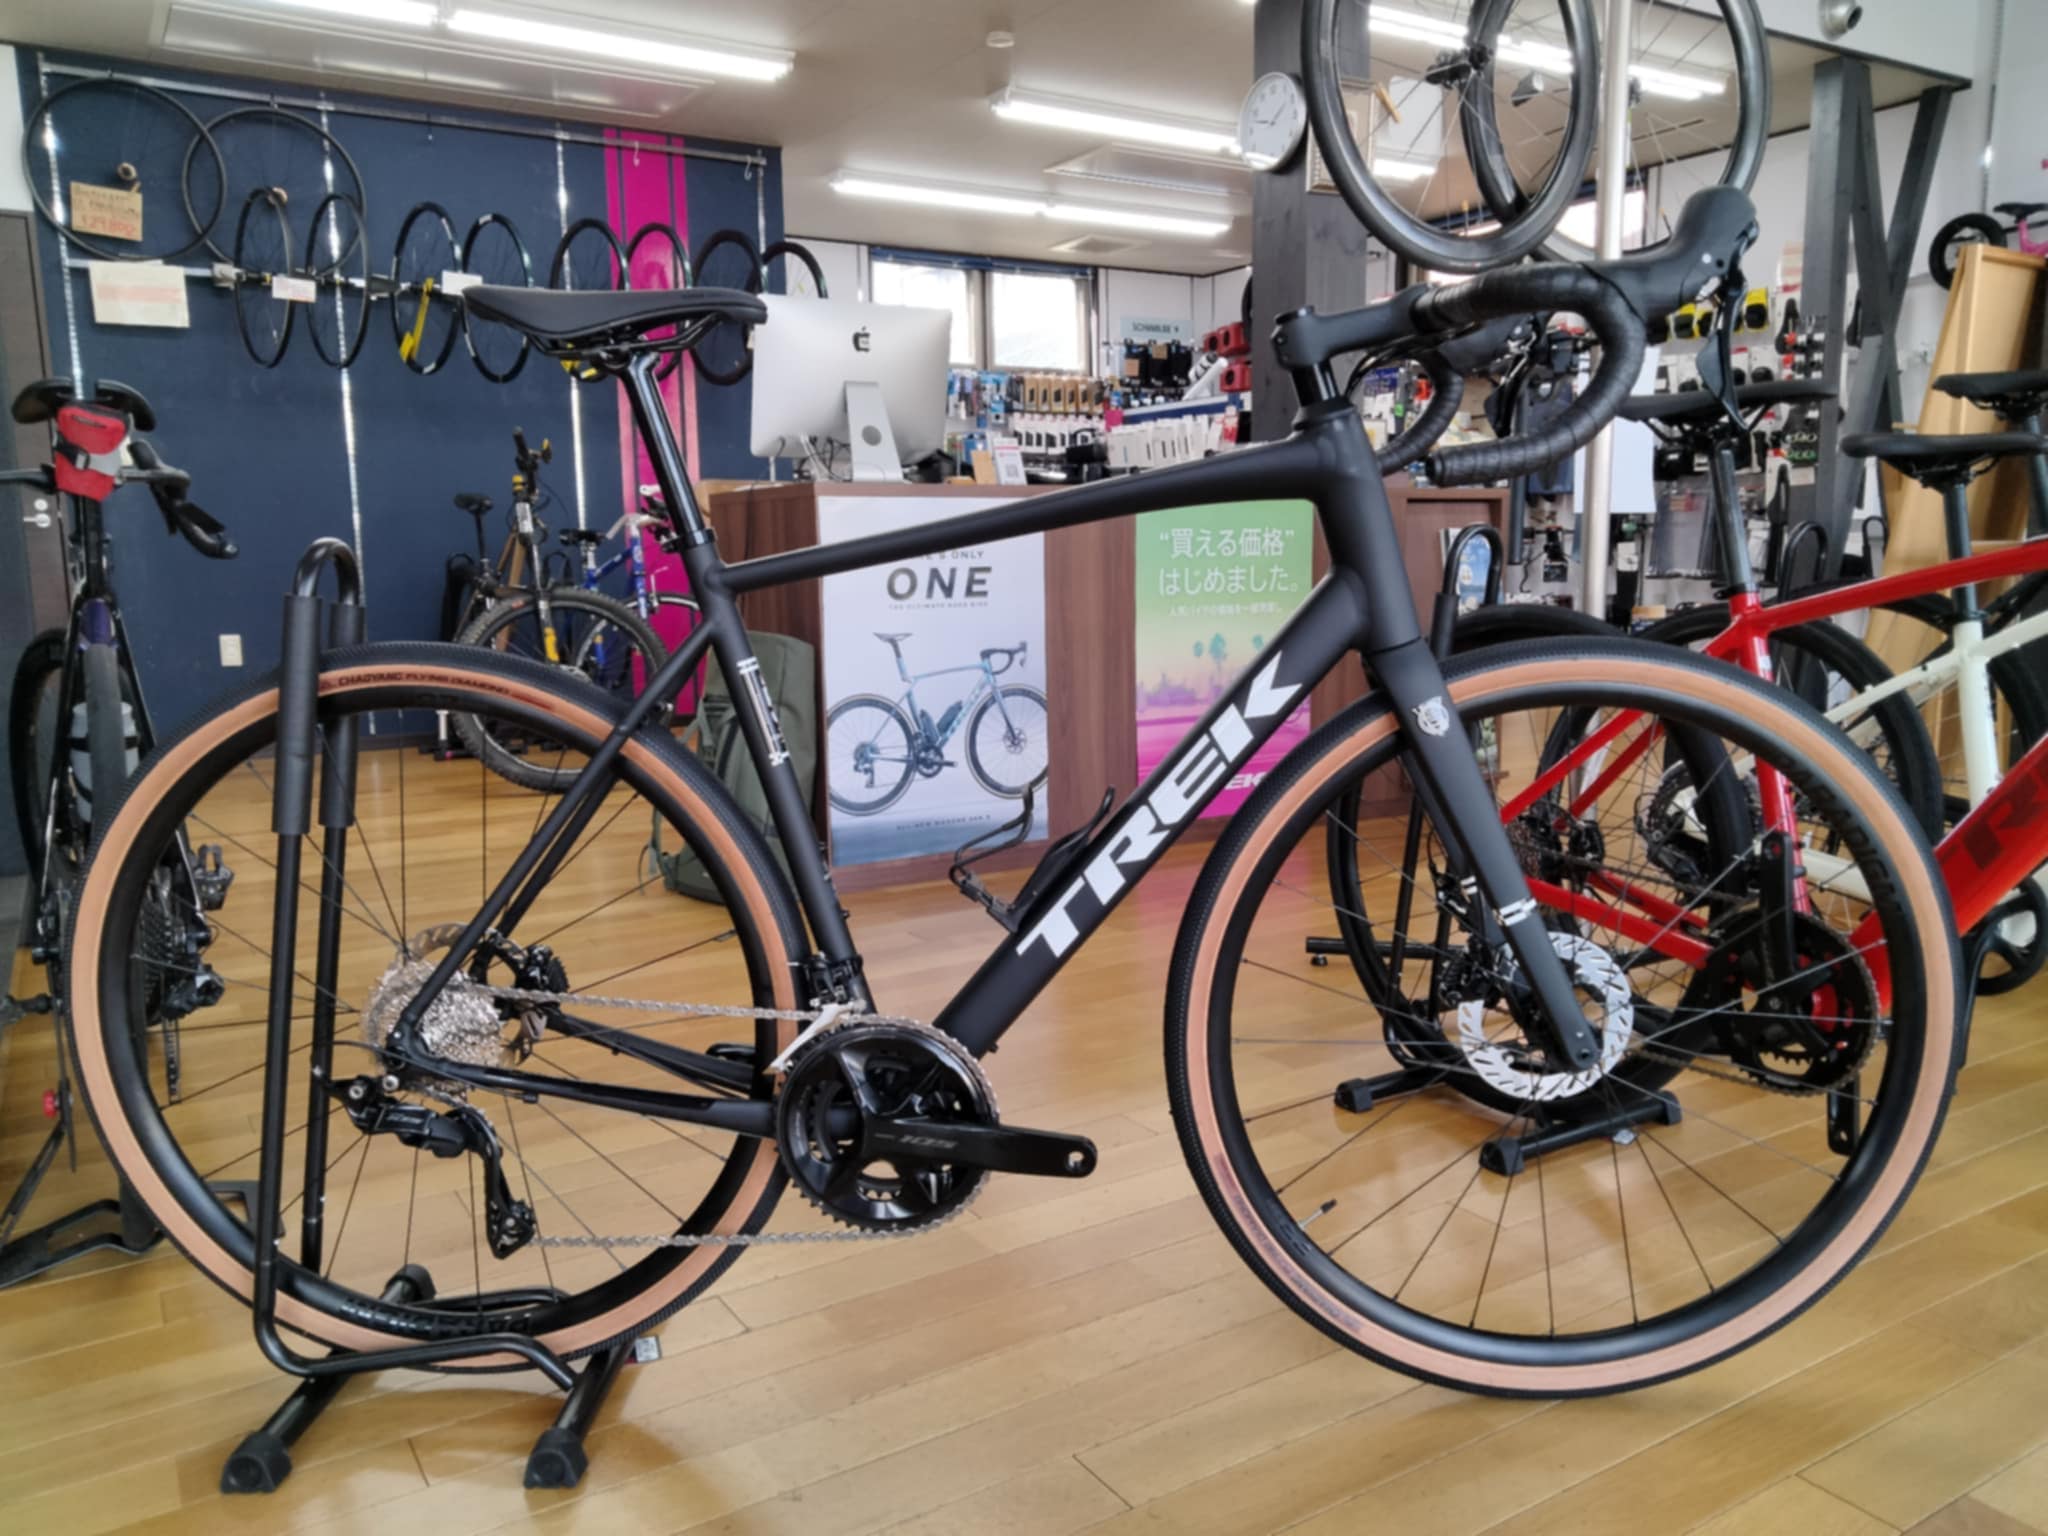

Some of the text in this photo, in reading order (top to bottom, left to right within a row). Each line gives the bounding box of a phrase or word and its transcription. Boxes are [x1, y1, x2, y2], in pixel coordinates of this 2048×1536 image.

[951, 549, 984, 560] ONLY
[887, 566, 992, 600] ONE
[1159, 565, 1298, 595] はじめました。
[1016, 650, 1303, 957] TREK
